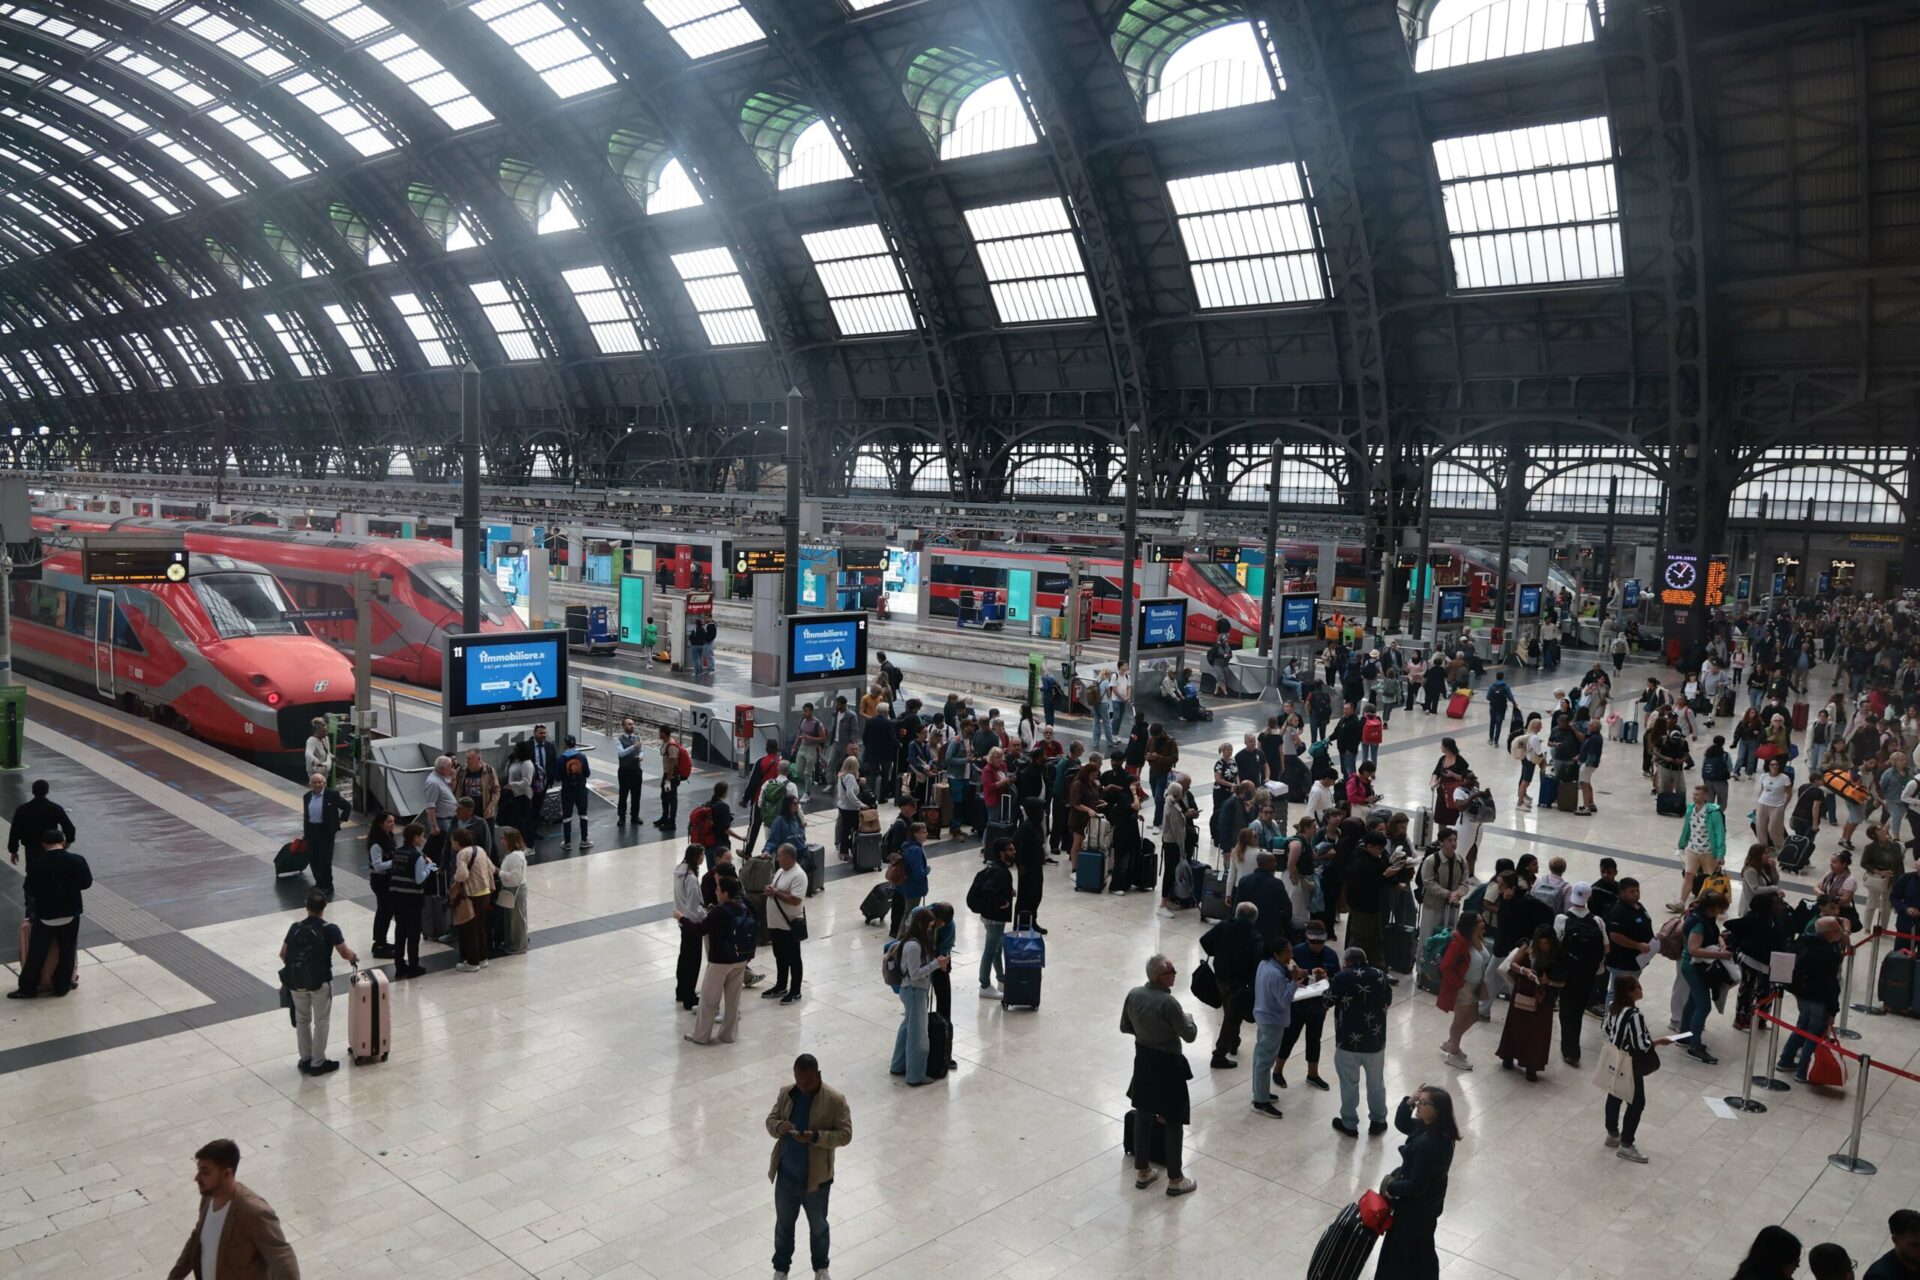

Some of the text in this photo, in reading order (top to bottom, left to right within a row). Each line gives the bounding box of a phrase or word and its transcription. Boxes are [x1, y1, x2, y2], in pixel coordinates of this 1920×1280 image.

[302, 610, 329, 618] fumatori
[453, 646, 463, 658] 11
[691, 711, 708, 729] 12
